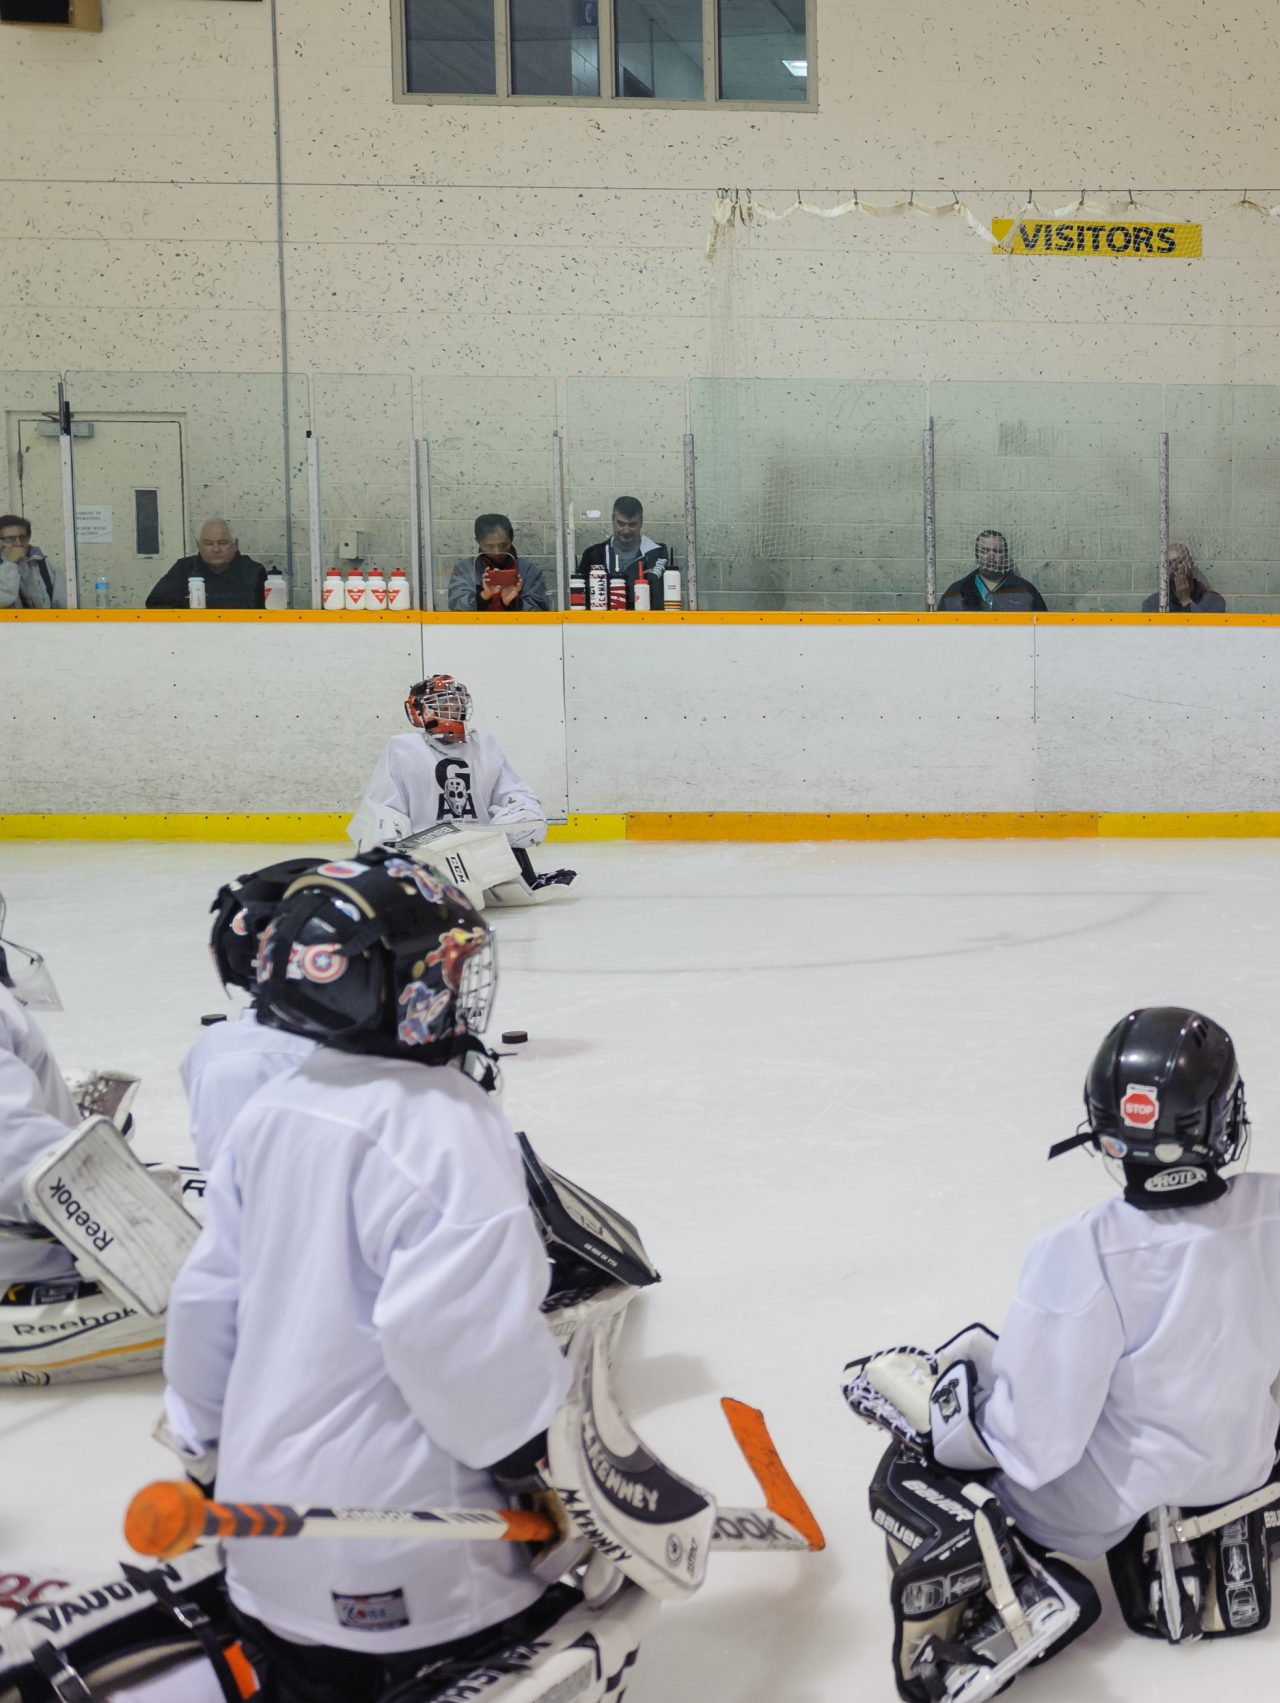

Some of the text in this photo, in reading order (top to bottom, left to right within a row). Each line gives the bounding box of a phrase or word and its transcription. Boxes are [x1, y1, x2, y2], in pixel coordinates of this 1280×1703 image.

[1018, 223, 1177, 254] VISITORS
[450, 856, 466, 883] CCM
[1125, 1102, 1154, 1115] STOP
[50, 1177, 115, 1253] Reebok
[13, 1305, 138, 1337] Reebok
[873, 1507, 925, 1550] BAUER
